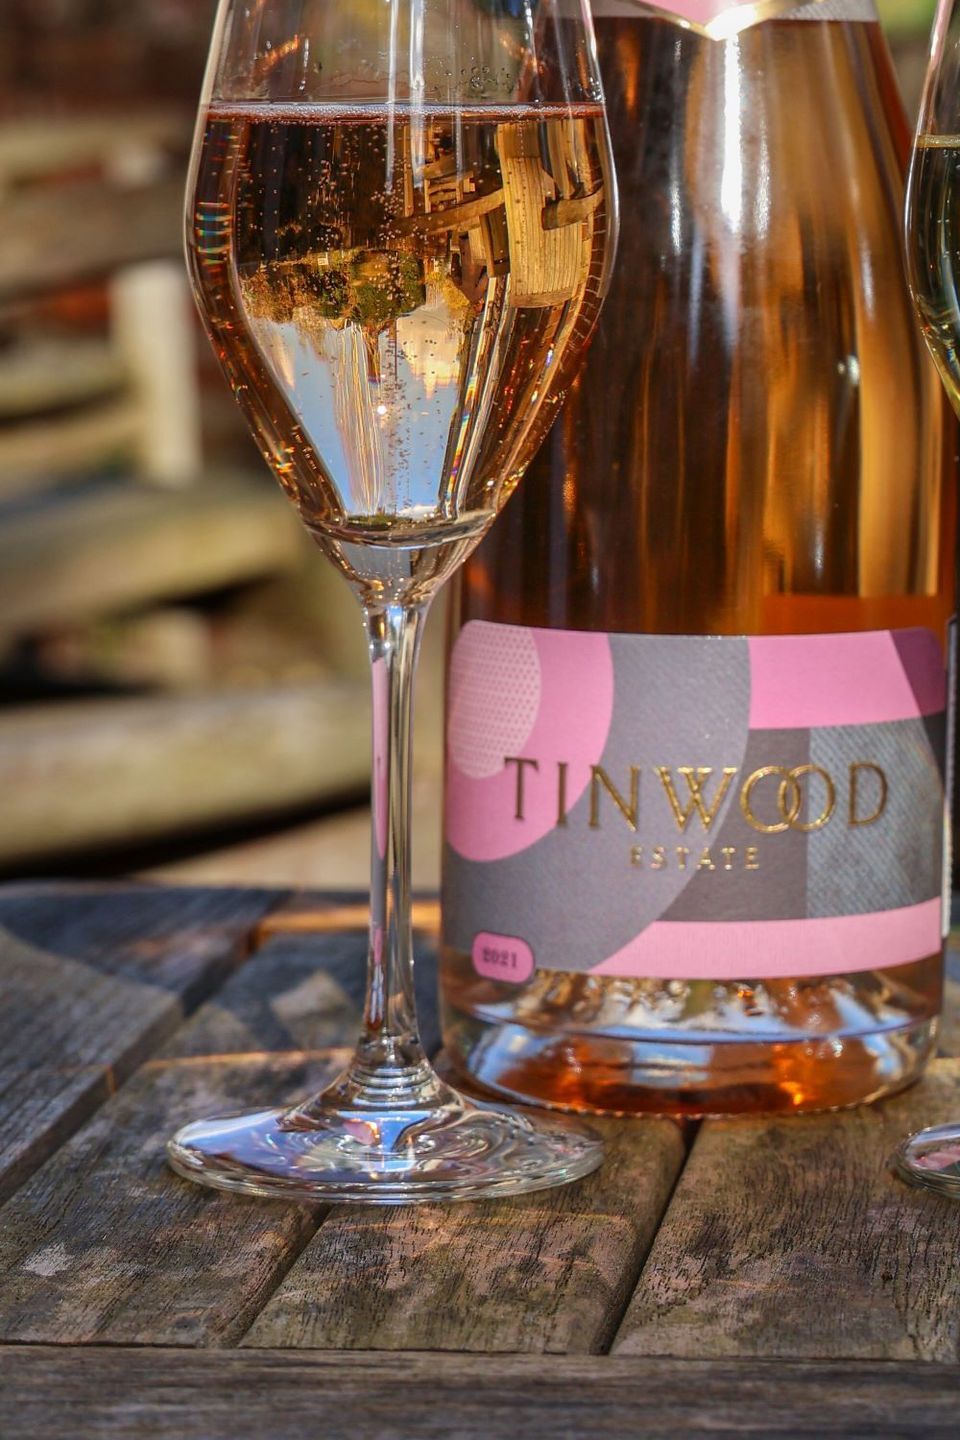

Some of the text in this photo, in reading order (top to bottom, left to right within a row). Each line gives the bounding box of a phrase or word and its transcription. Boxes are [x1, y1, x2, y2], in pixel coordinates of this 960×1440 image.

[504, 756, 889, 833] TINWOOD
[630, 845, 760, 870] ESTATE
[482, 946, 517, 969] 2021
